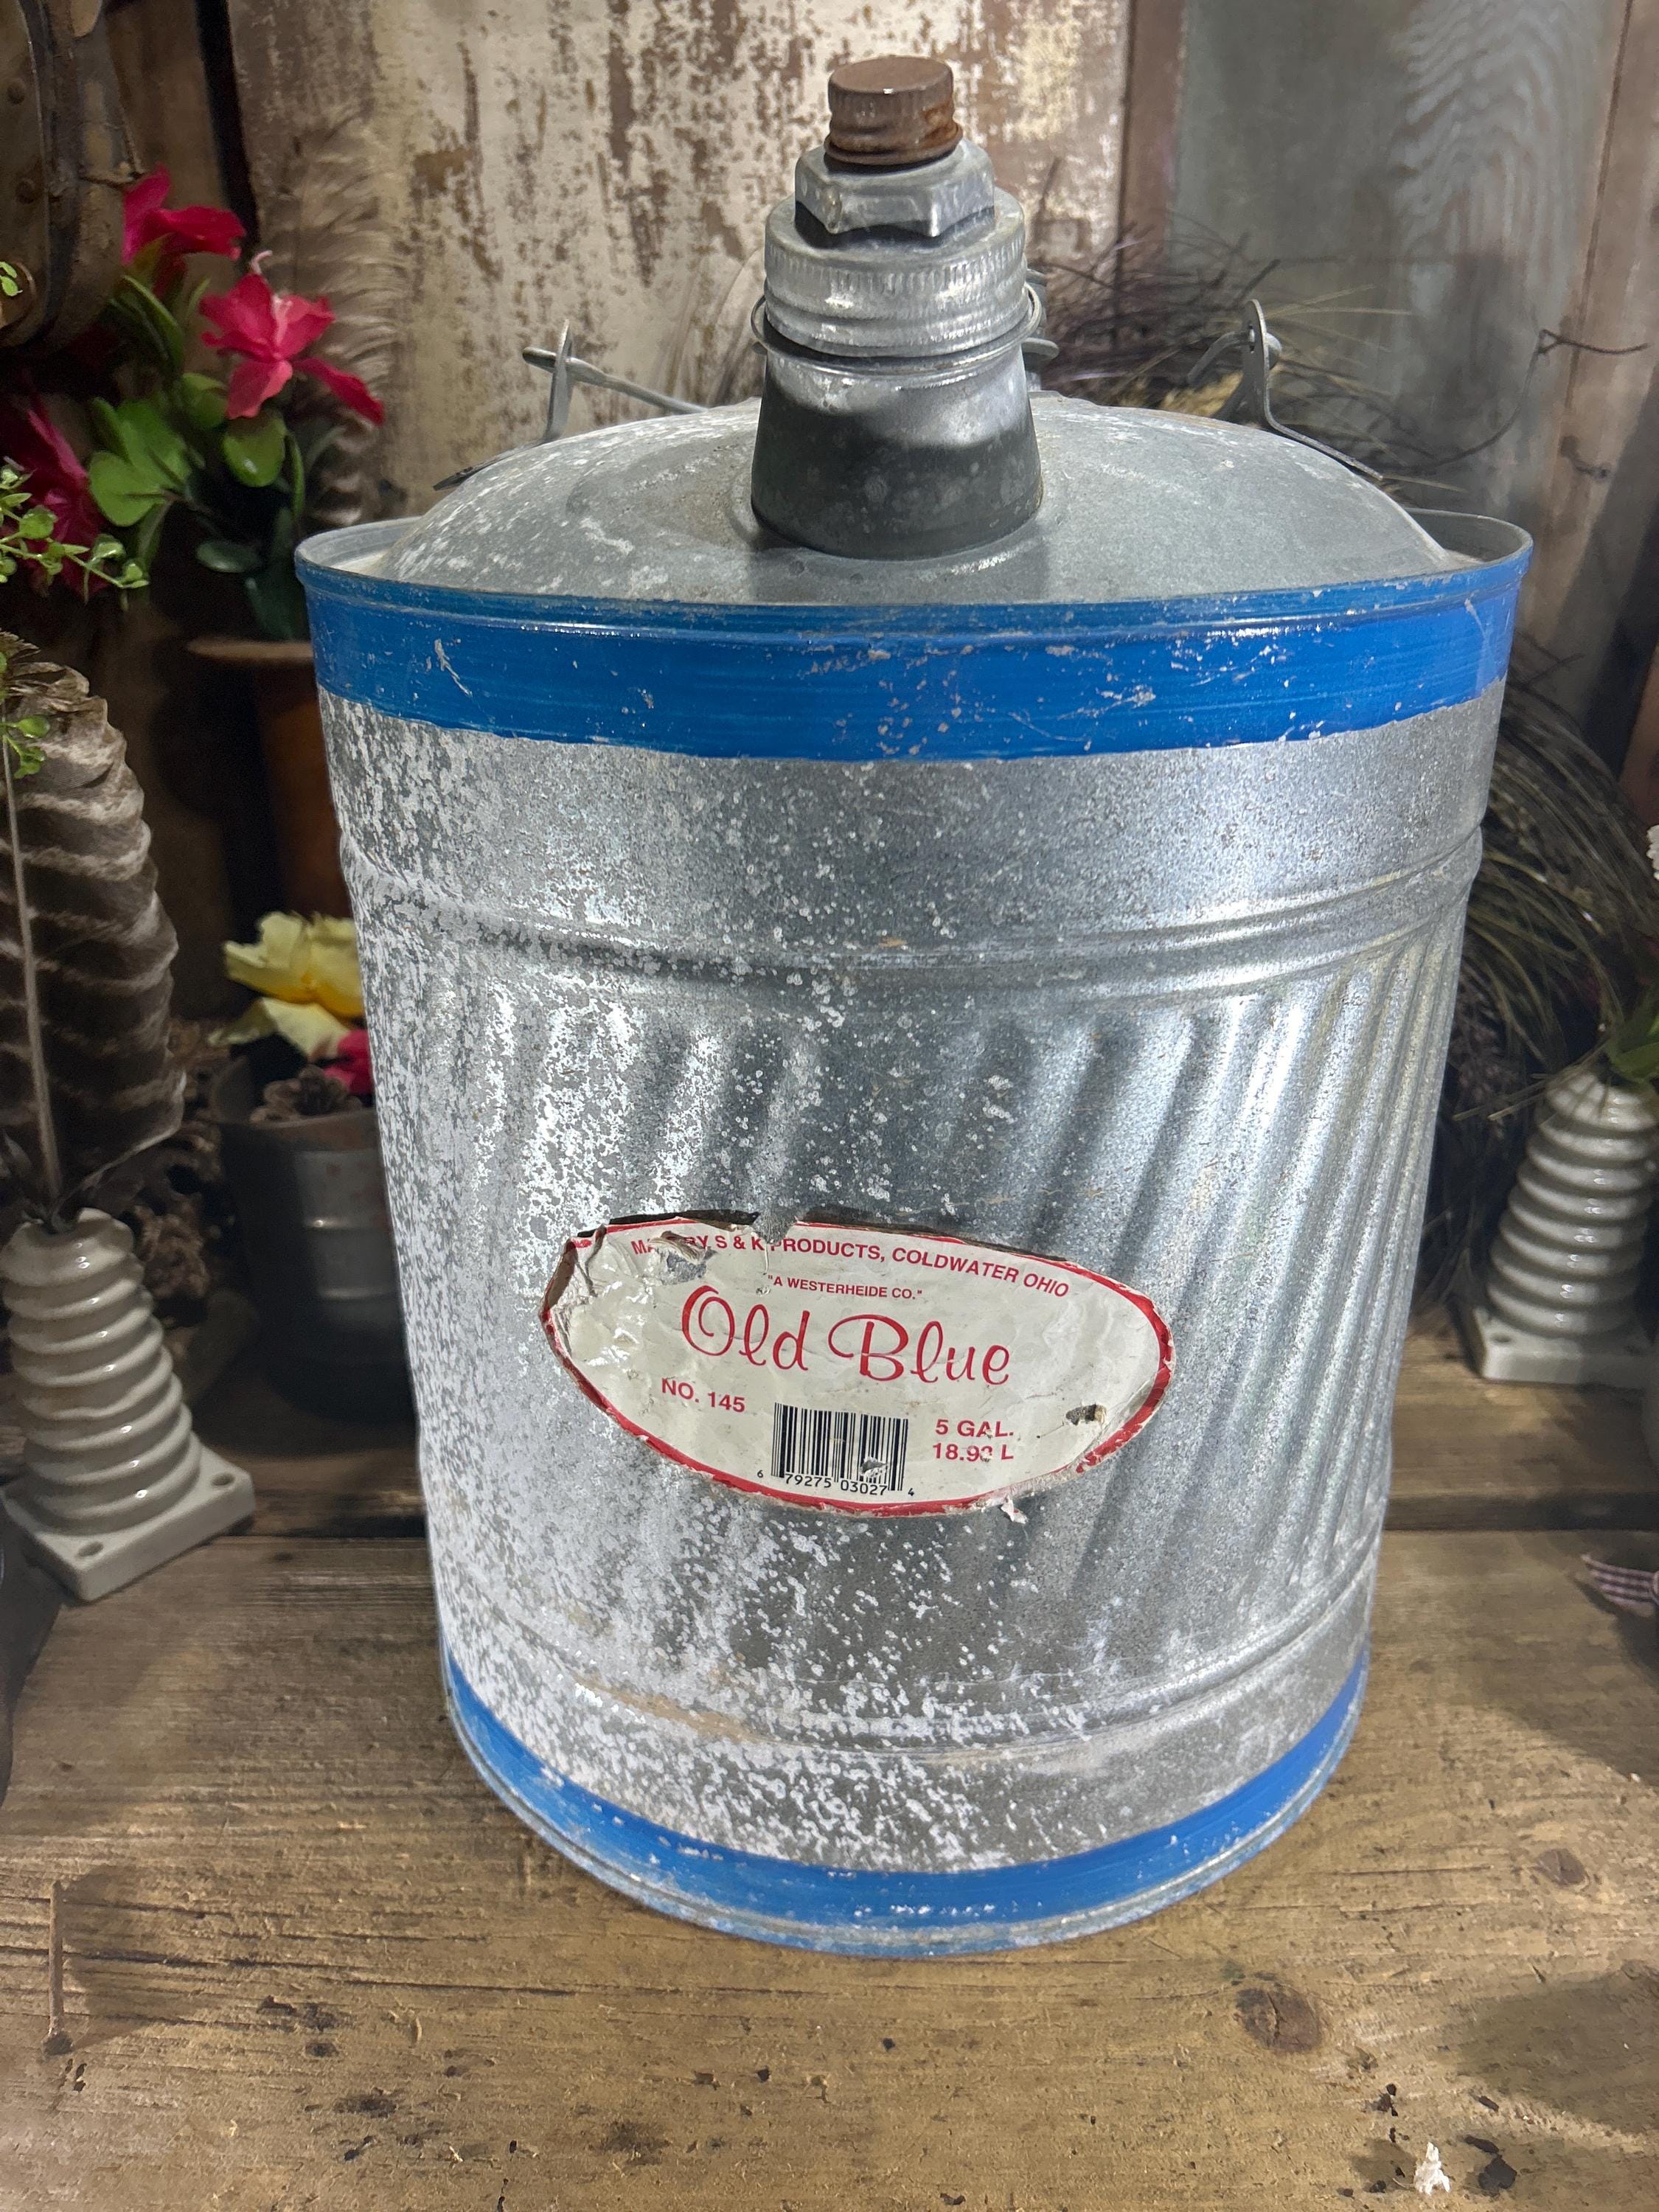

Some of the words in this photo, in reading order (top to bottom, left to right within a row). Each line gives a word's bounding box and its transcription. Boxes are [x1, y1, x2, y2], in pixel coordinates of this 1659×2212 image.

[714, 1235, 728, 1249] S
[733, 1236, 746, 1250] &
[751, 1237, 765, 1251] K
[891, 1247, 1020, 1283] COLDWATER
[1023, 1273, 1069, 1298] OHIO
[768, 1274, 783, 1287] "A
[787, 1277, 888, 1298] WESTERHEIDE
[681, 1285, 810, 1371] Old
[827, 1313, 1010, 1385] Blue
[661, 1377, 700, 1403] NO.
[707, 1391, 745, 1413] 145
[935, 1419, 949, 1436] 5
[957, 1419, 1015, 1439] GAL.
[1001, 1444, 1015, 1461] L
[757, 1470, 764, 1478] 6
[785, 1472, 832, 1488] 79275
[840, 1479, 888, 1496] 03027
[908, 1487, 915, 1497] 4
